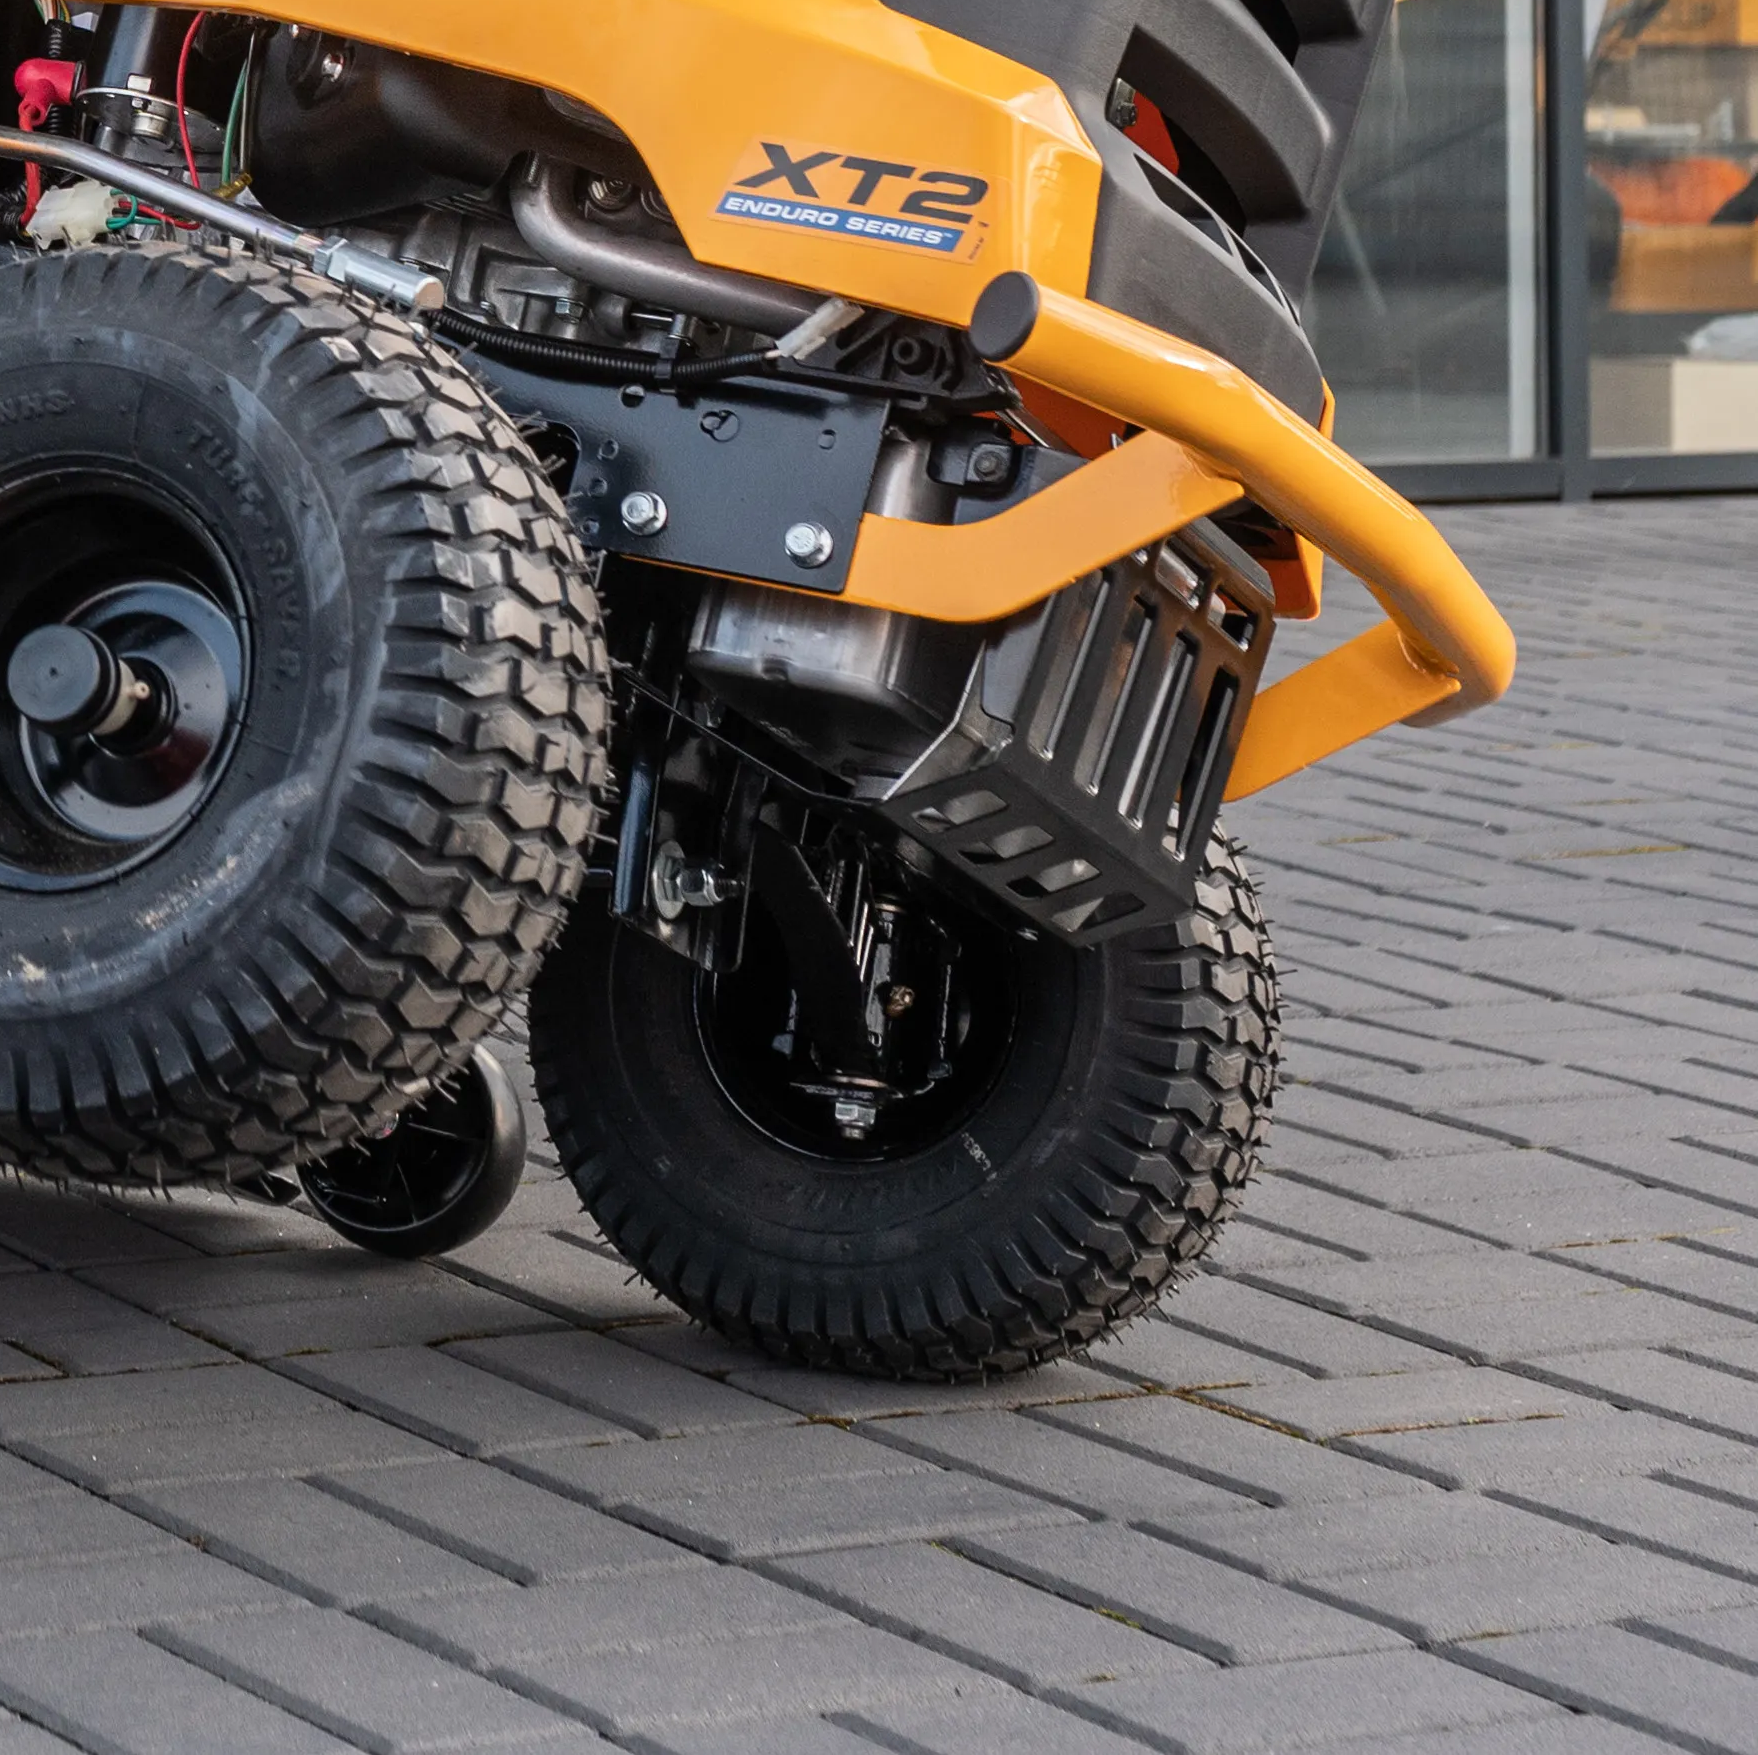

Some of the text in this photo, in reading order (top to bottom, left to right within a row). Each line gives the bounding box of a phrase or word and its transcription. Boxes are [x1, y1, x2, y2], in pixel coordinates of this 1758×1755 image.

[733, 141, 990, 224] XT2
[723, 196, 944, 246] ENDURO SERIES
